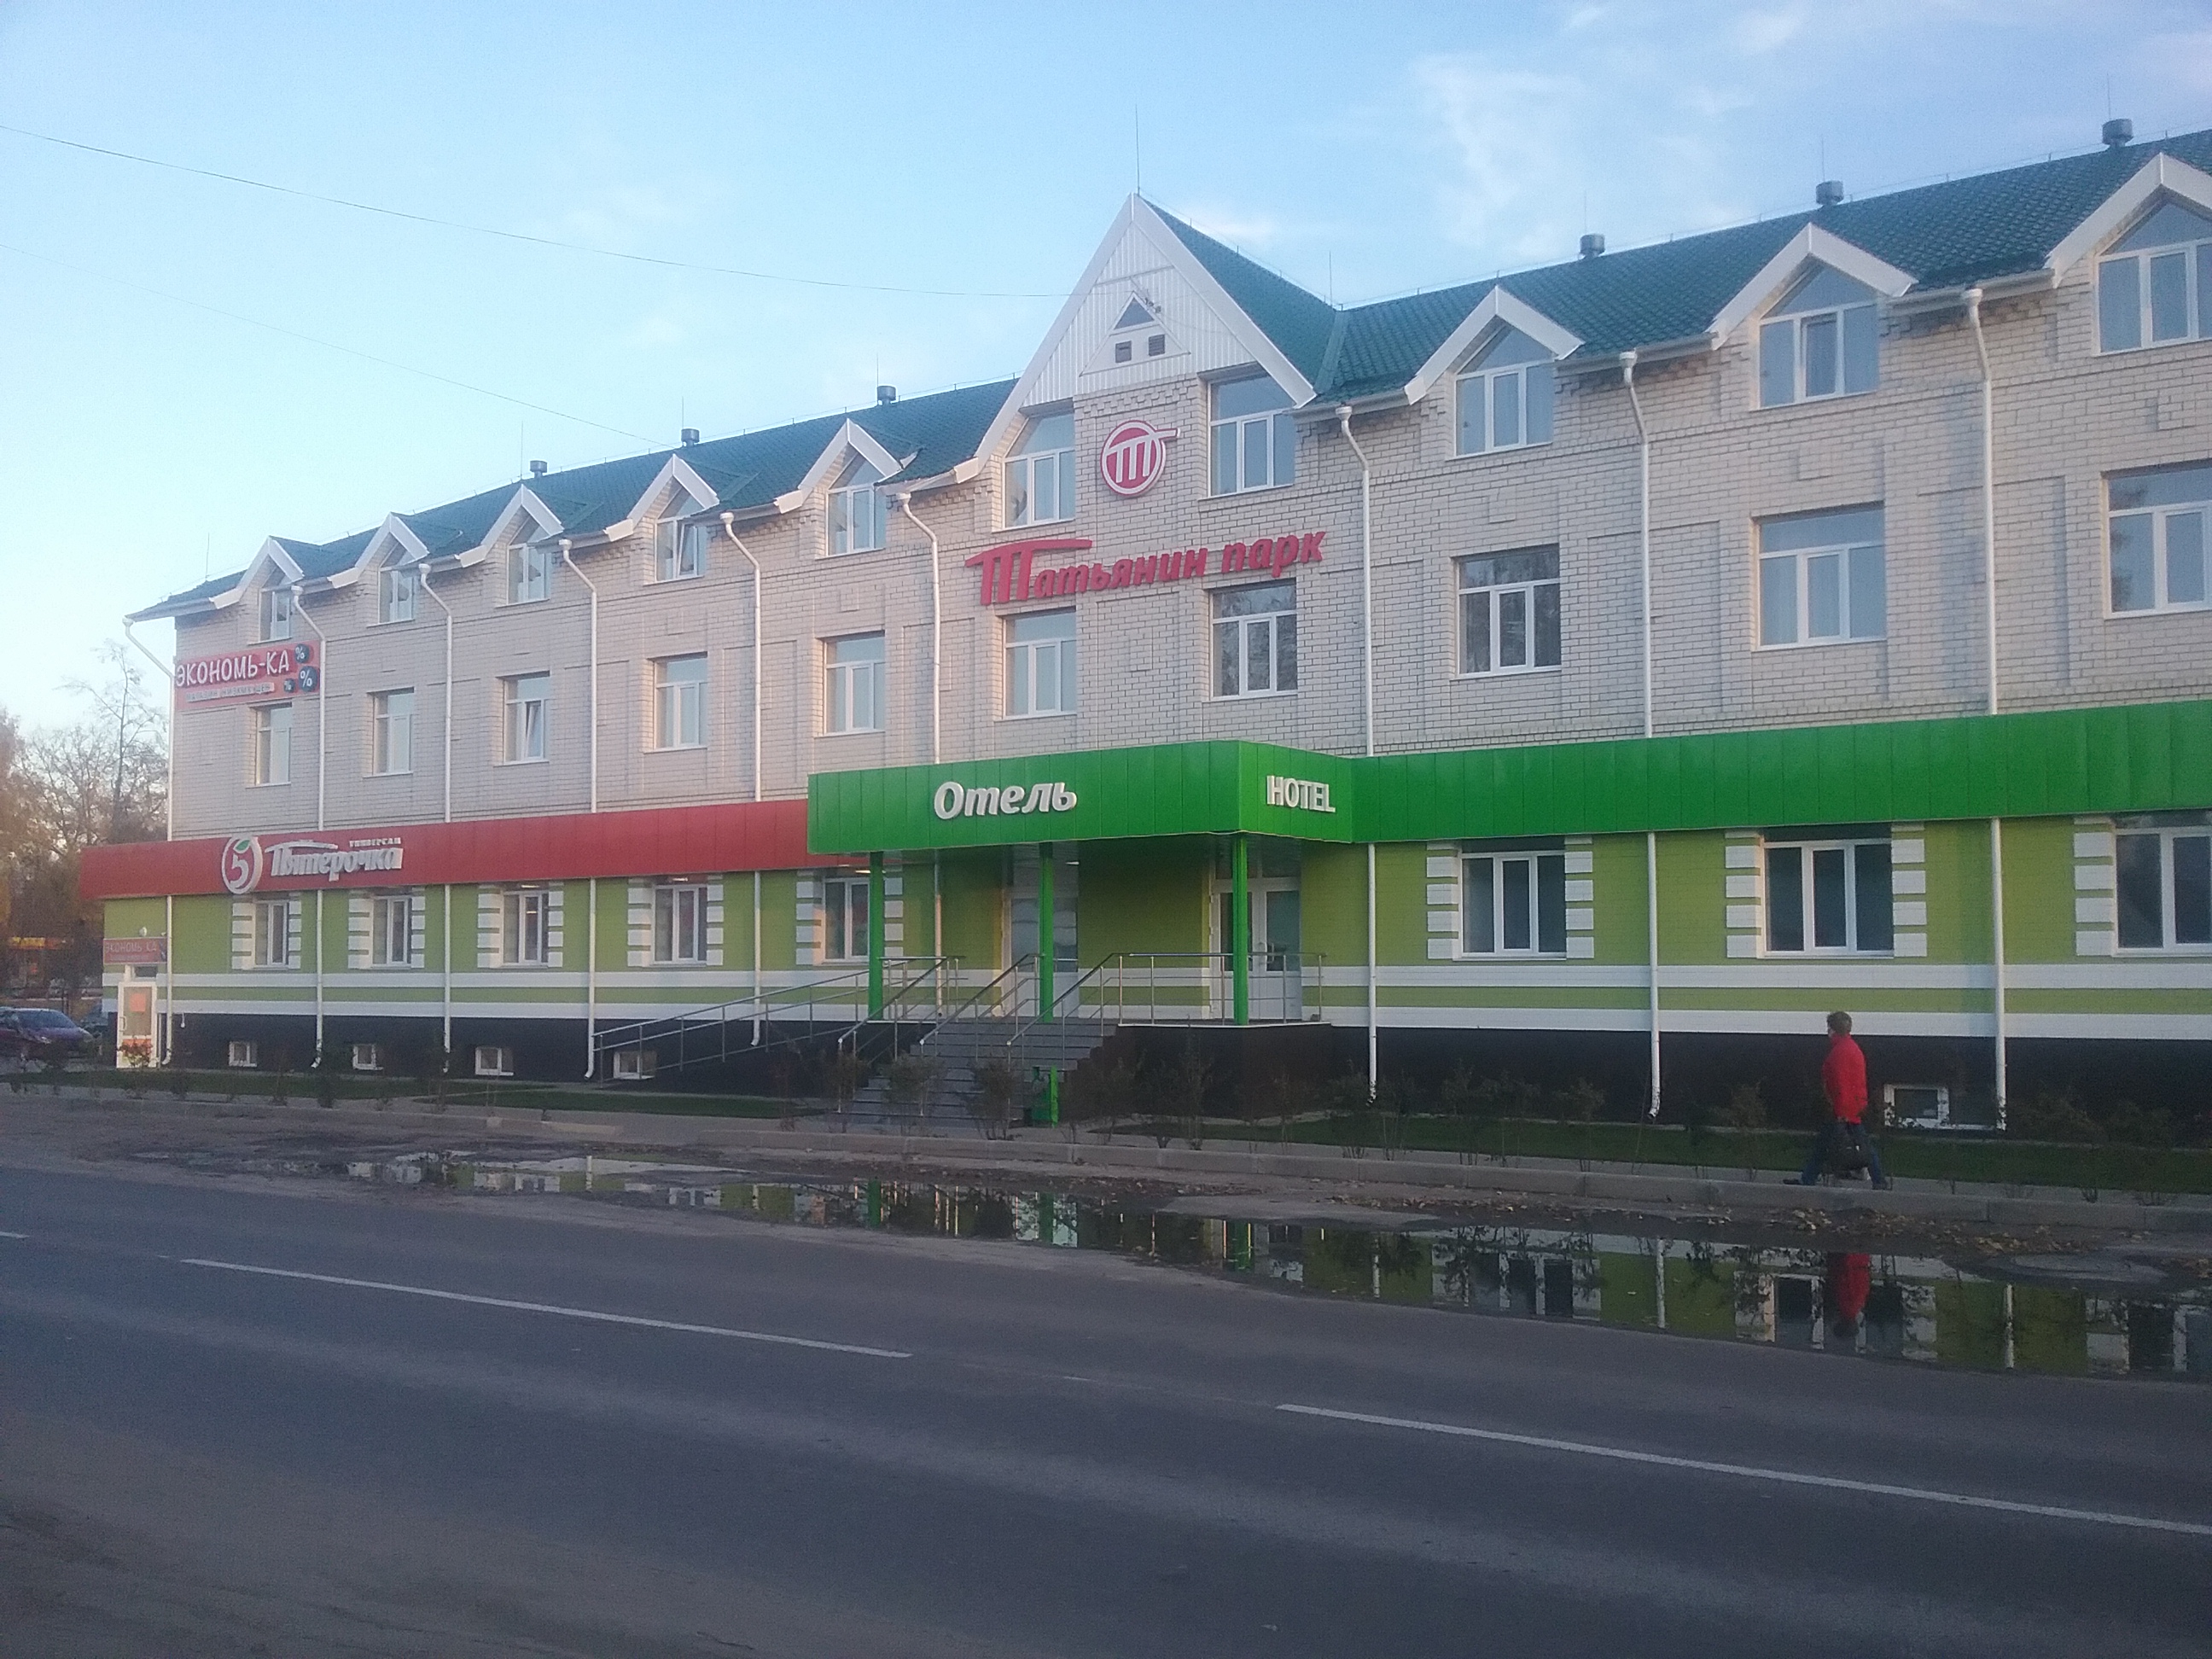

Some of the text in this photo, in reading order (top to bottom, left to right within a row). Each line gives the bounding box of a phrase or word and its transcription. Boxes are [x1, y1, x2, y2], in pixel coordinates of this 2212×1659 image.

[965, 531, 1326, 606] Татьянин парк
[175, 649, 290, 687] ЭКОНОМЬ-КА
[934, 781, 1078, 820] Отель
[1266, 775, 1336, 813] HOTEL
[265, 840, 404, 882] Пятерочка
